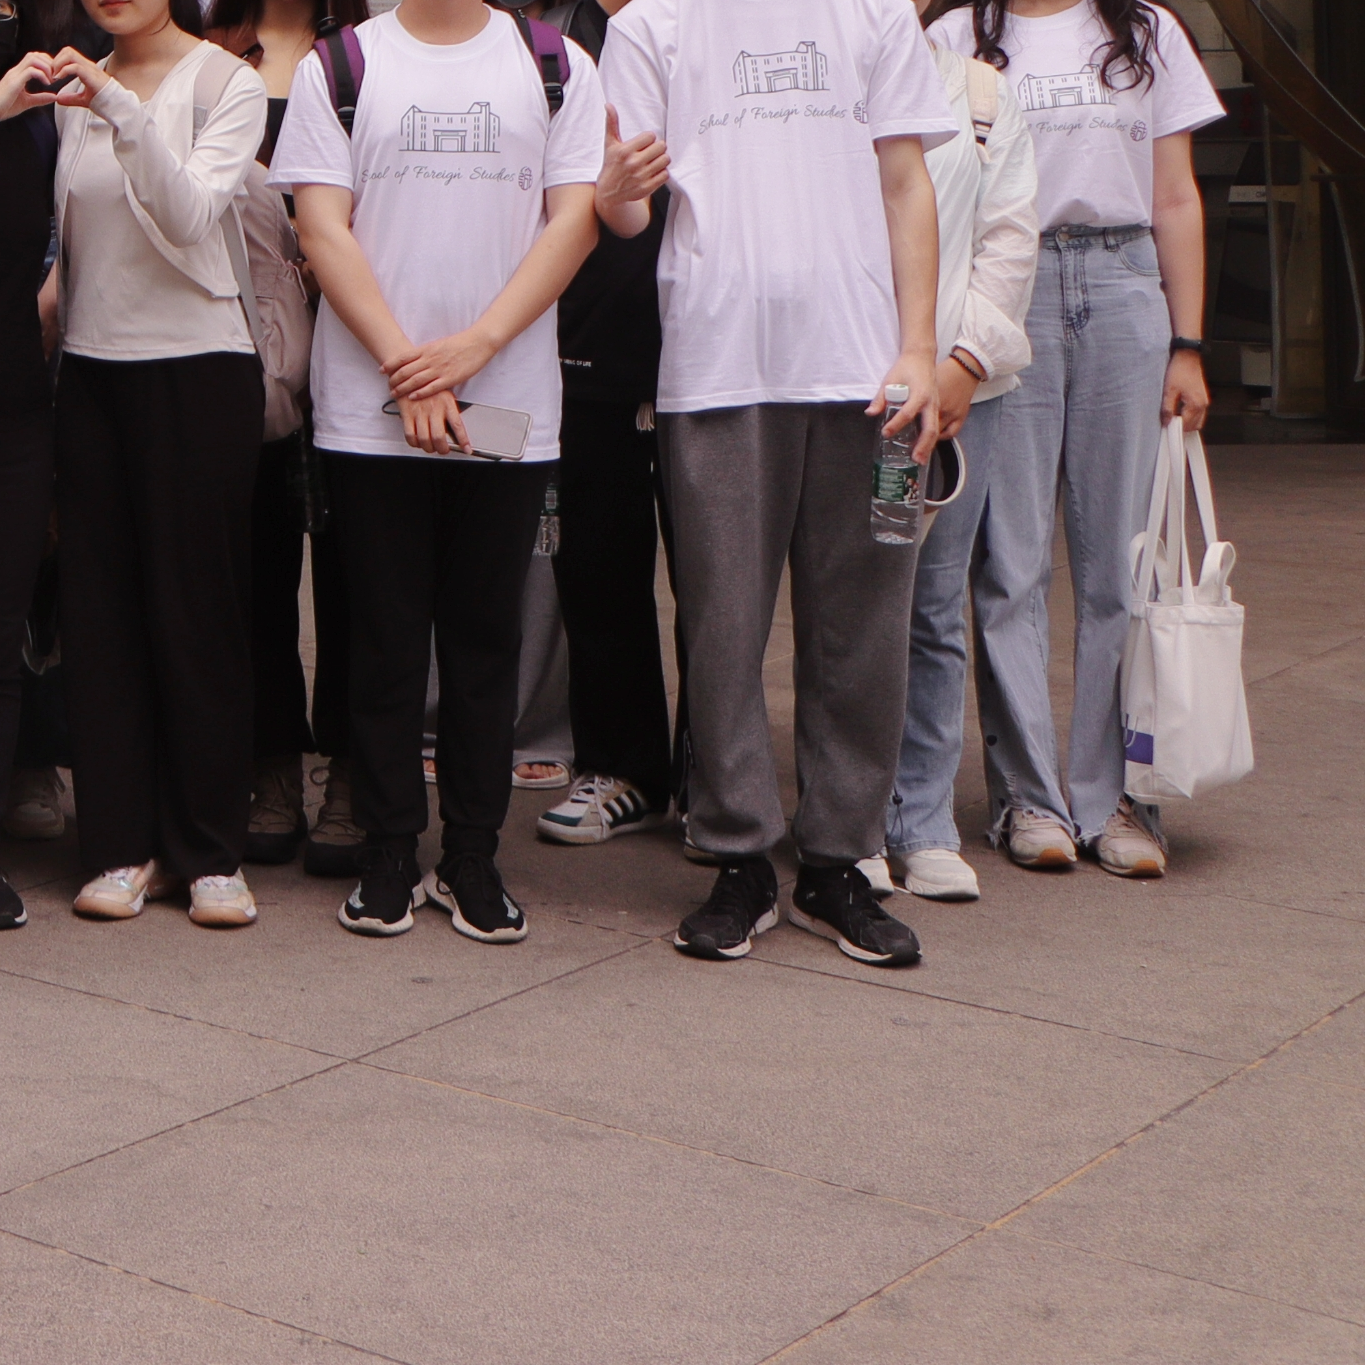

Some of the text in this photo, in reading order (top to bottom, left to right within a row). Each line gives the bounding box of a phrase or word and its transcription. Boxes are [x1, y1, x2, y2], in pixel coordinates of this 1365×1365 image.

[734, 108, 747, 128] of
[751, 104, 801, 124] Foreign
[804, 104, 849, 120] Studies
[1035, 119, 1083, 137] Foreign
[394, 165, 410, 185] of
[413, 165, 463, 187] Foreign
[469, 166, 516, 183] Studies
